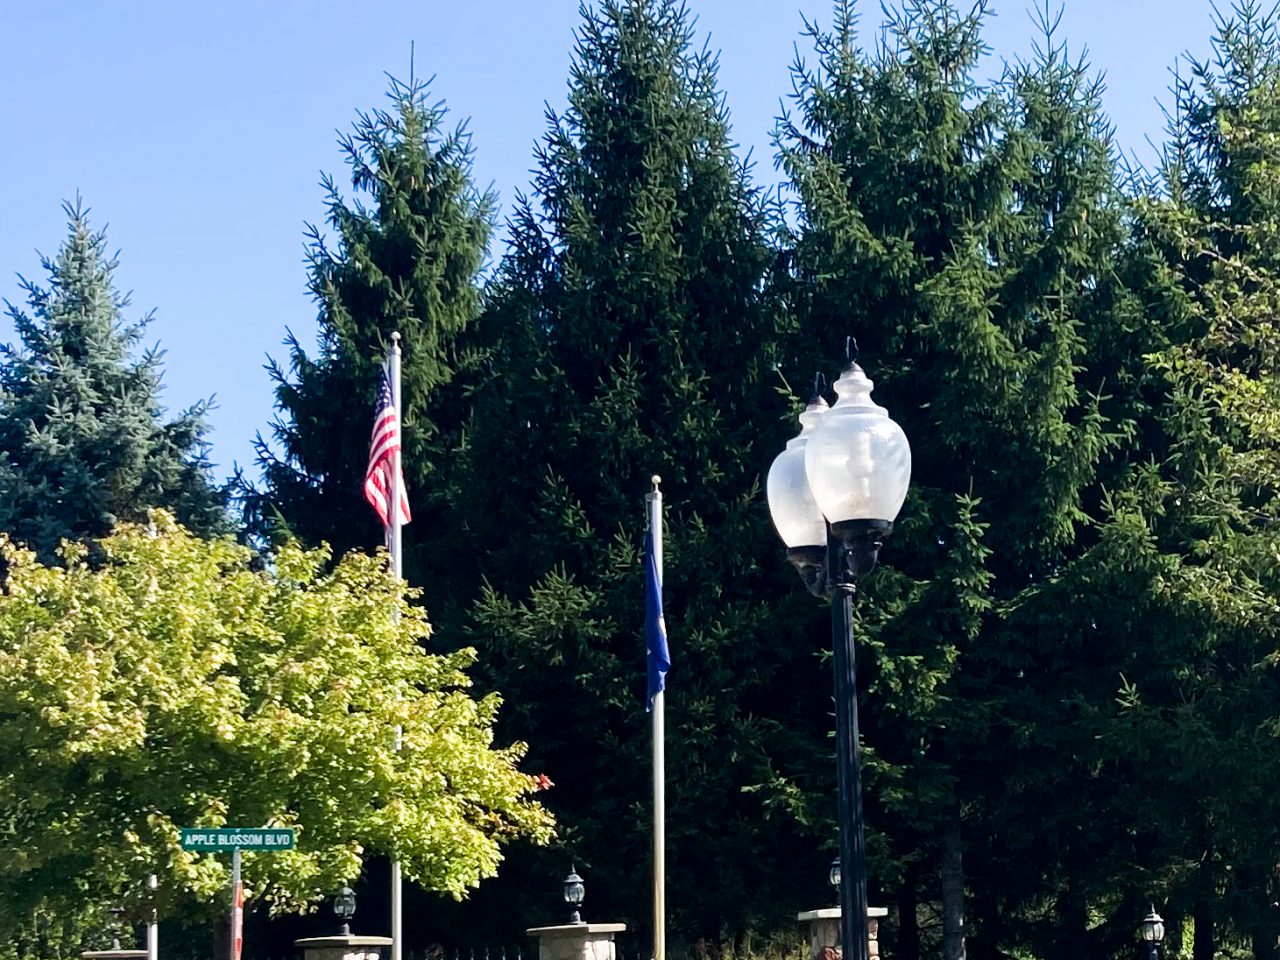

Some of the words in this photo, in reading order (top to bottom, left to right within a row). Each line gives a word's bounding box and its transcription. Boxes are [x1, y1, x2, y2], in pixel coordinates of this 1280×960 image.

[184, 834, 216, 846] APPLE
[218, 834, 263, 845] BLOSSOM
[265, 834, 290, 845] BLVD
